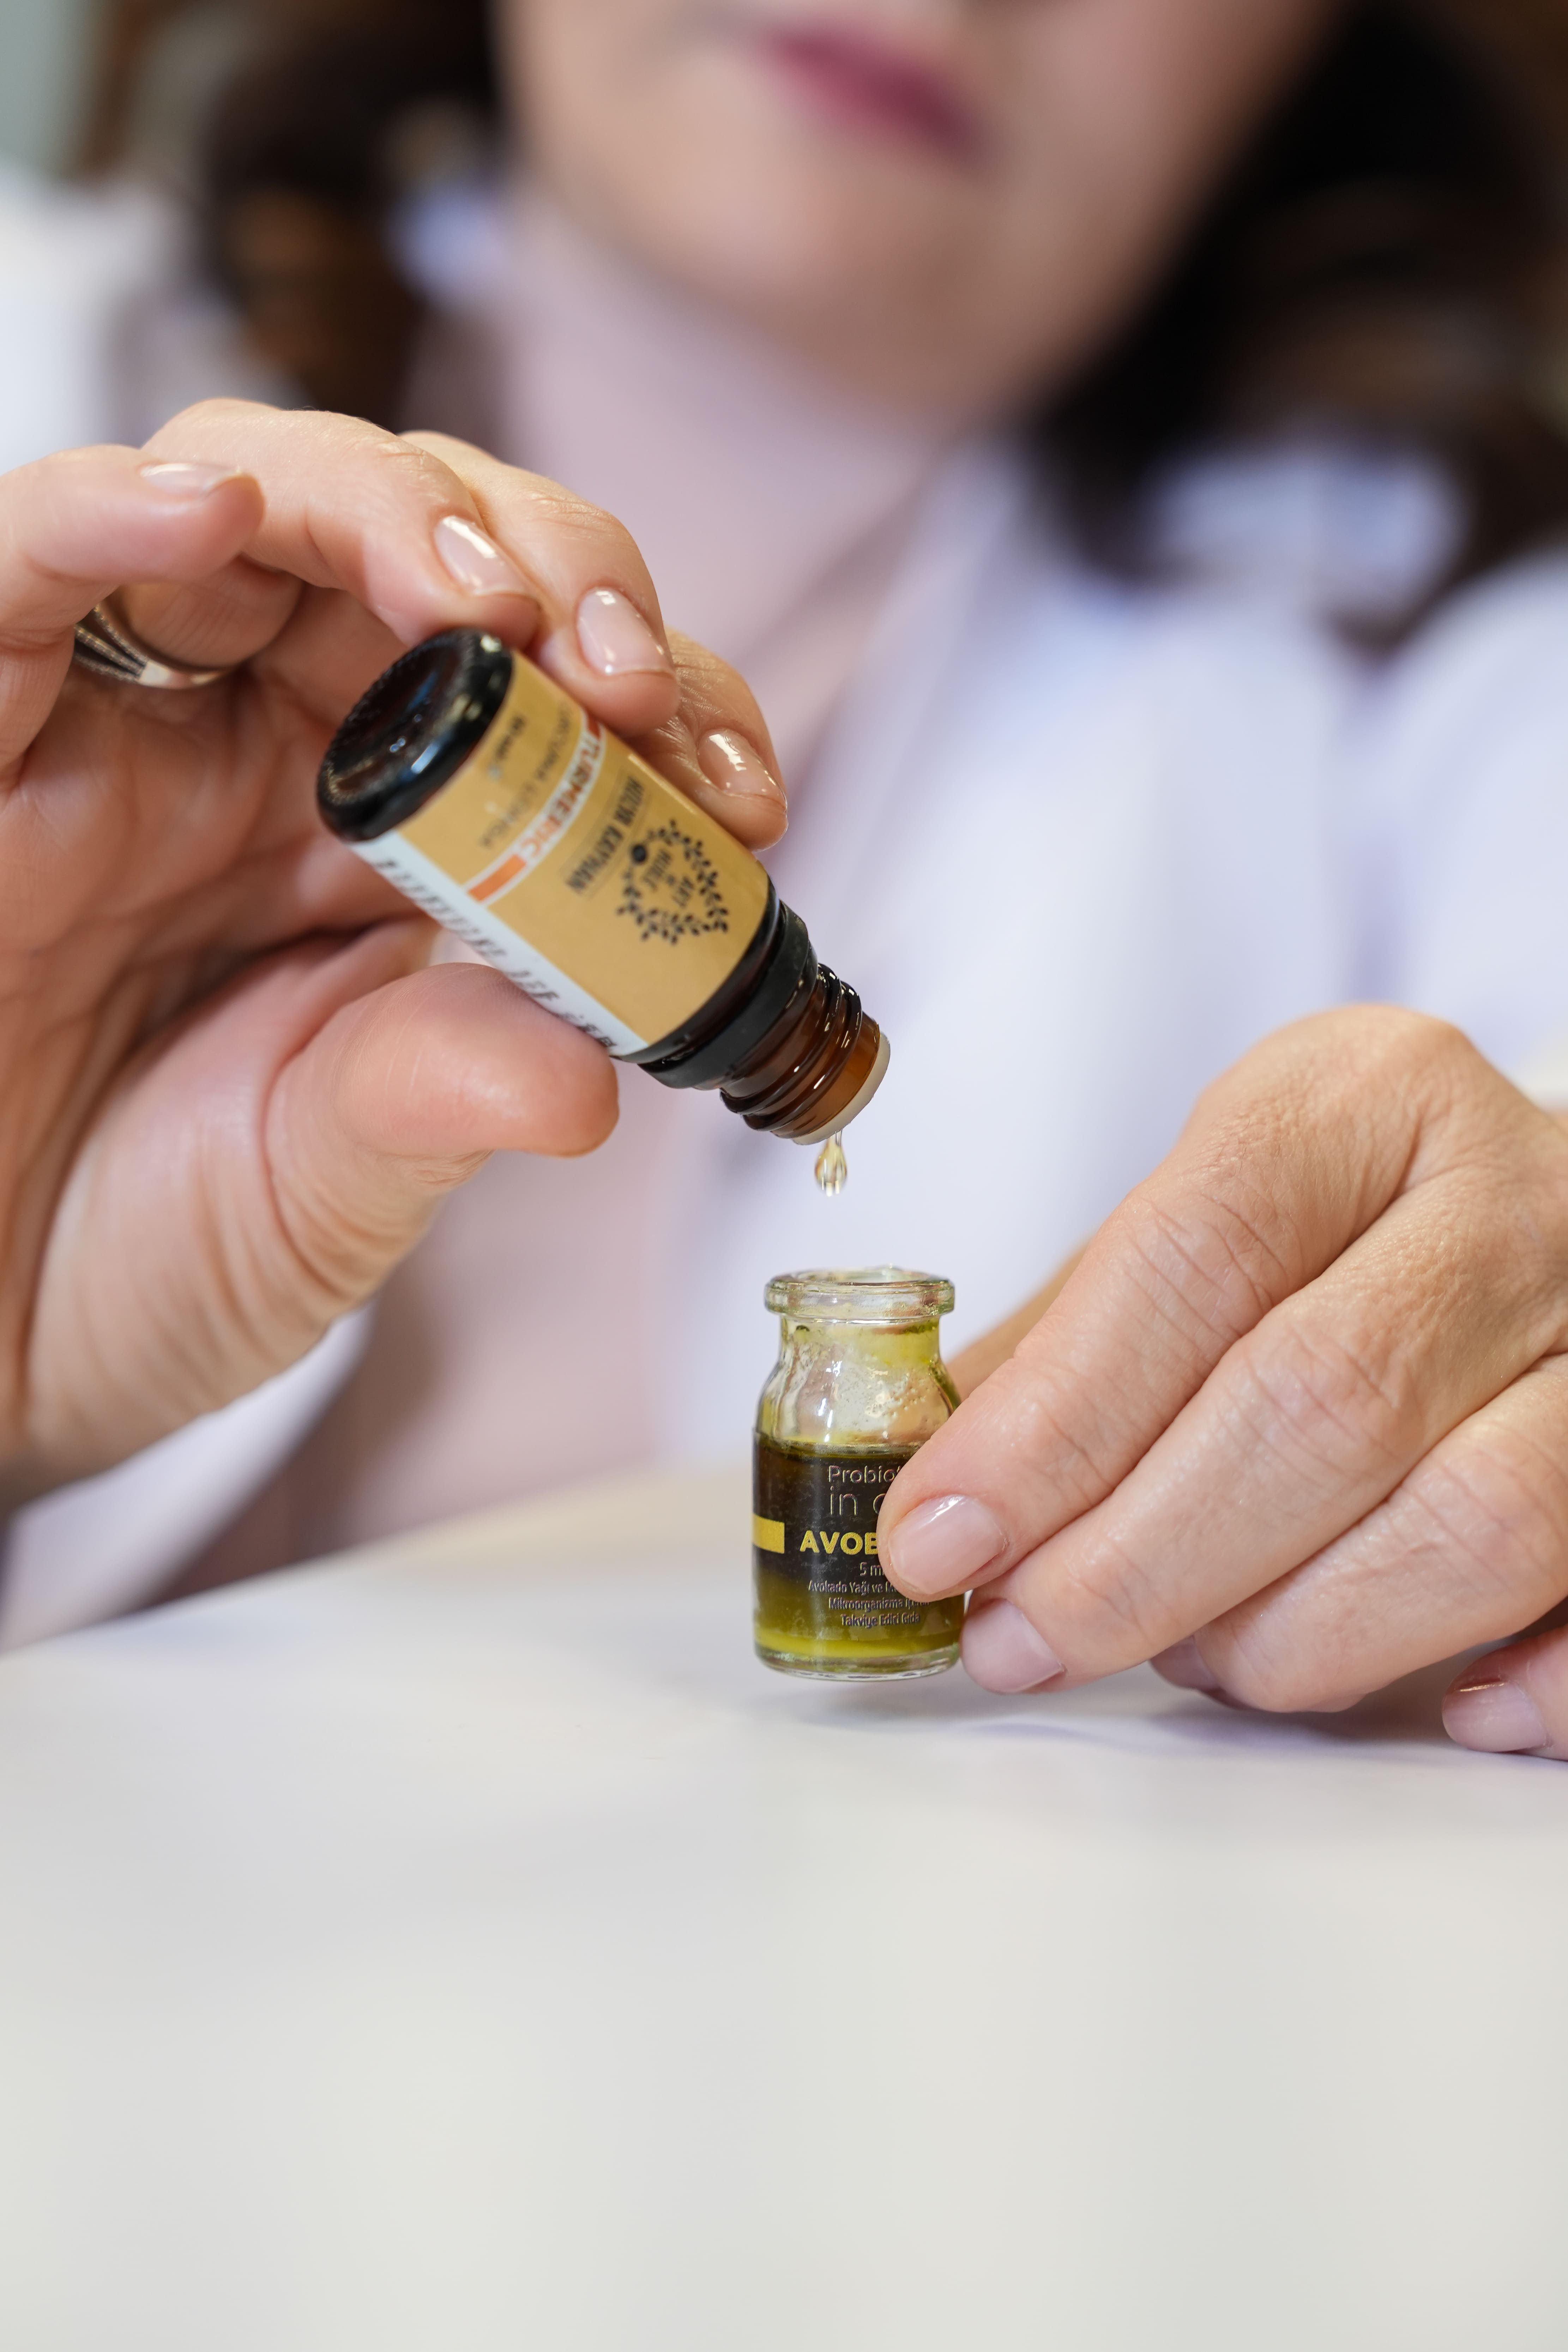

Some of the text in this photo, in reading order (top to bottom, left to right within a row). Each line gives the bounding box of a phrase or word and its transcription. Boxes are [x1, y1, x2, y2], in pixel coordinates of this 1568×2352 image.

[523, 736, 601, 857] TURMERIC
[673, 876, 694, 908] ART
[830, 1486, 858, 1516] in
[860, 1562, 867, 1576] 5
[808, 1580, 847, 1593] Avokado
[872, 1584, 883, 1593] ve
[829, 1597, 903, 1612] Mikroorganizma
[840, 1614, 878, 1629] Takviye
